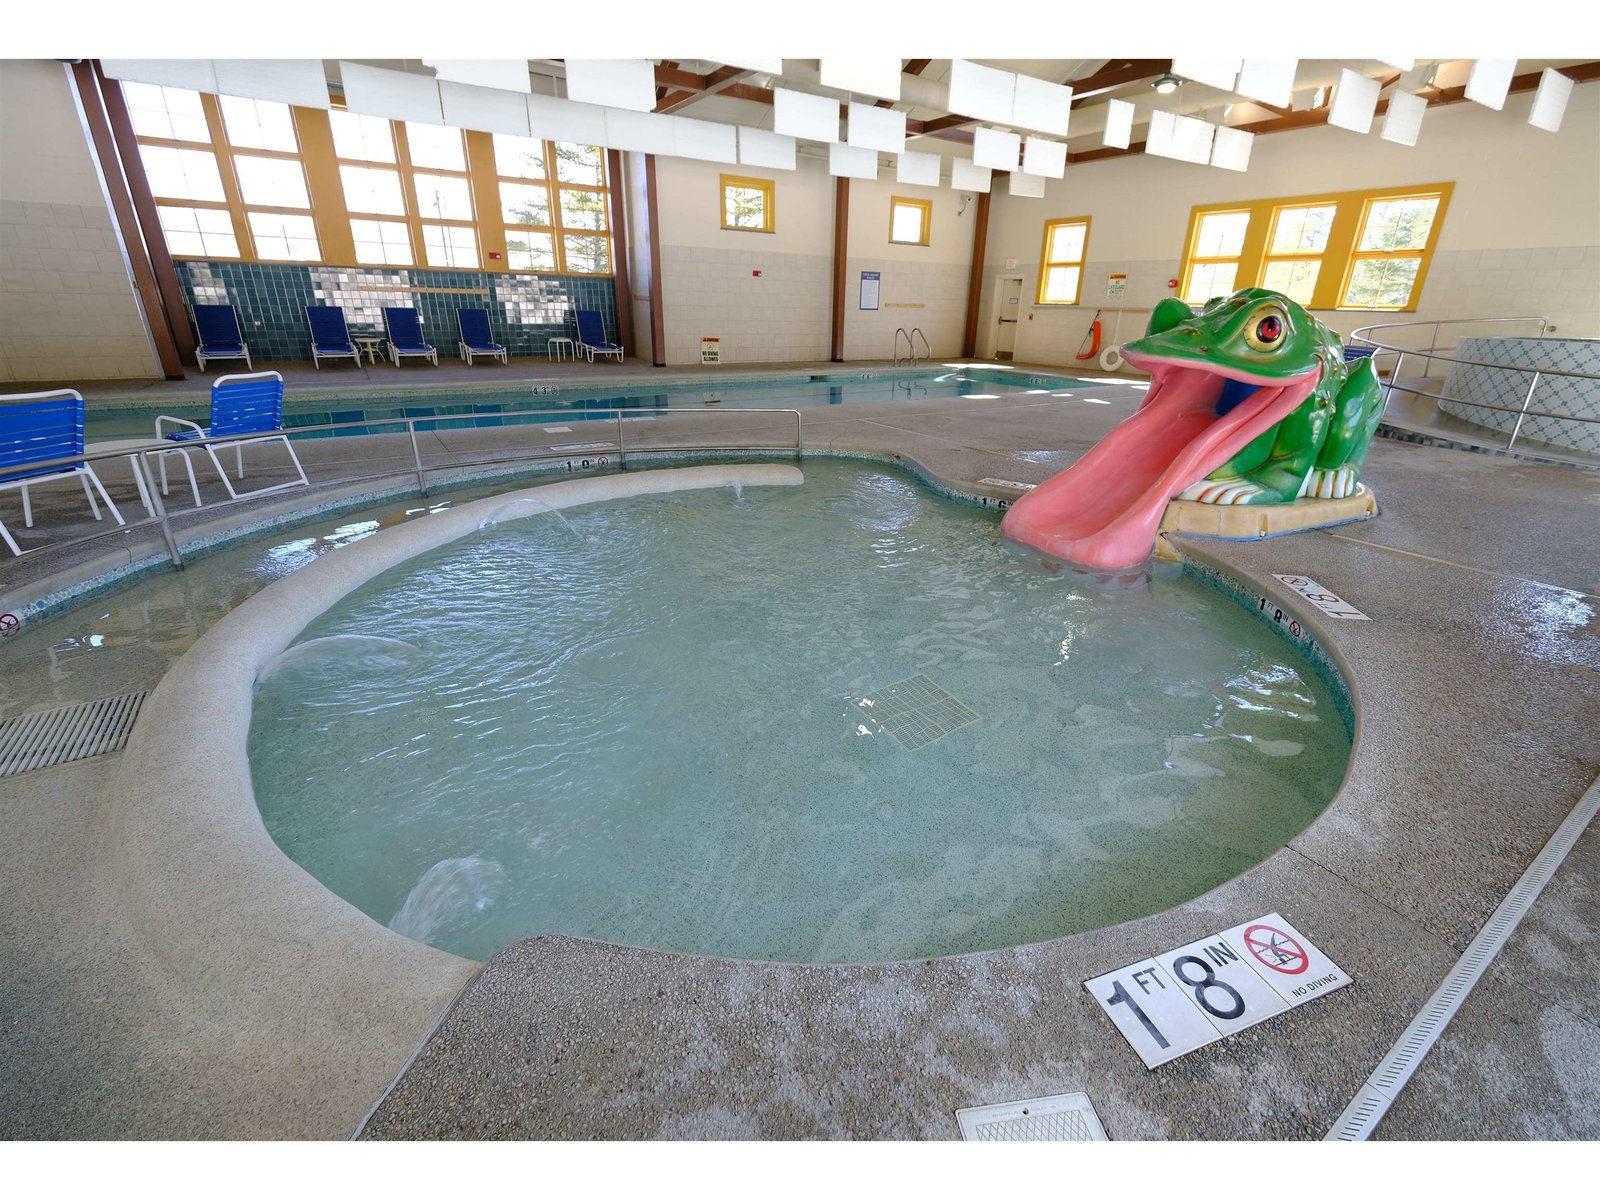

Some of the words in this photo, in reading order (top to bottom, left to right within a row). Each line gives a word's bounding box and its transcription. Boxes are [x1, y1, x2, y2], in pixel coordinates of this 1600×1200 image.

[1260, 597, 1266, 611] 1
[1274, 608, 1283, 624] 8
[1202, 941, 1240, 968] IN
[1131, 966, 1166, 996] FT
[1173, 955, 1246, 1020] 8
[1291, 986, 1308, 998] NO
[1306, 973, 1338, 991] DIVING
[1106, 980, 1171, 1050] 1
